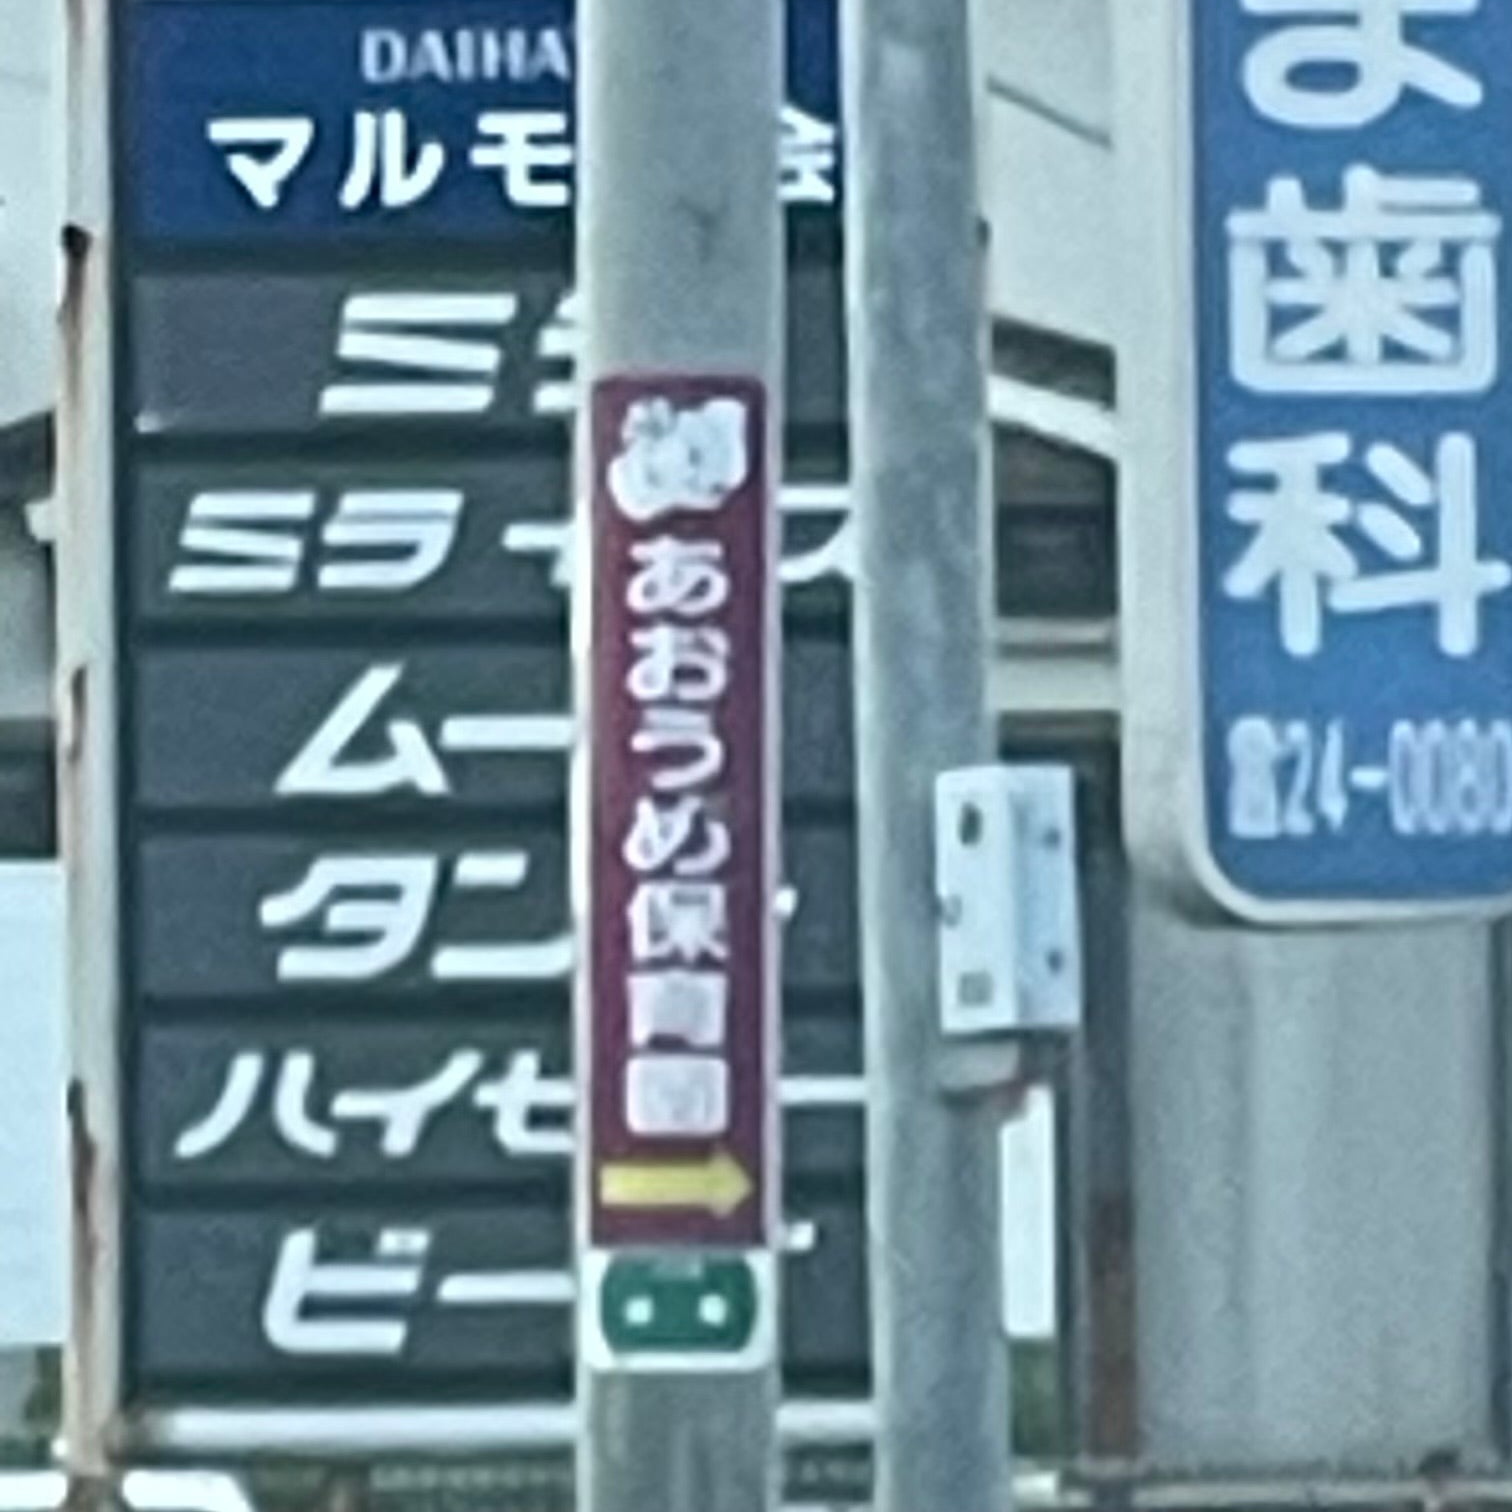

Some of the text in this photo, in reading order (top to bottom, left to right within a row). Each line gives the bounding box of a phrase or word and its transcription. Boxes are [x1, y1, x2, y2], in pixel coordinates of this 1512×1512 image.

[361, 29, 571, 84] DAIHA
[207, 104, 838, 211] マルモ会
[274, 664, 576, 795] ムー
